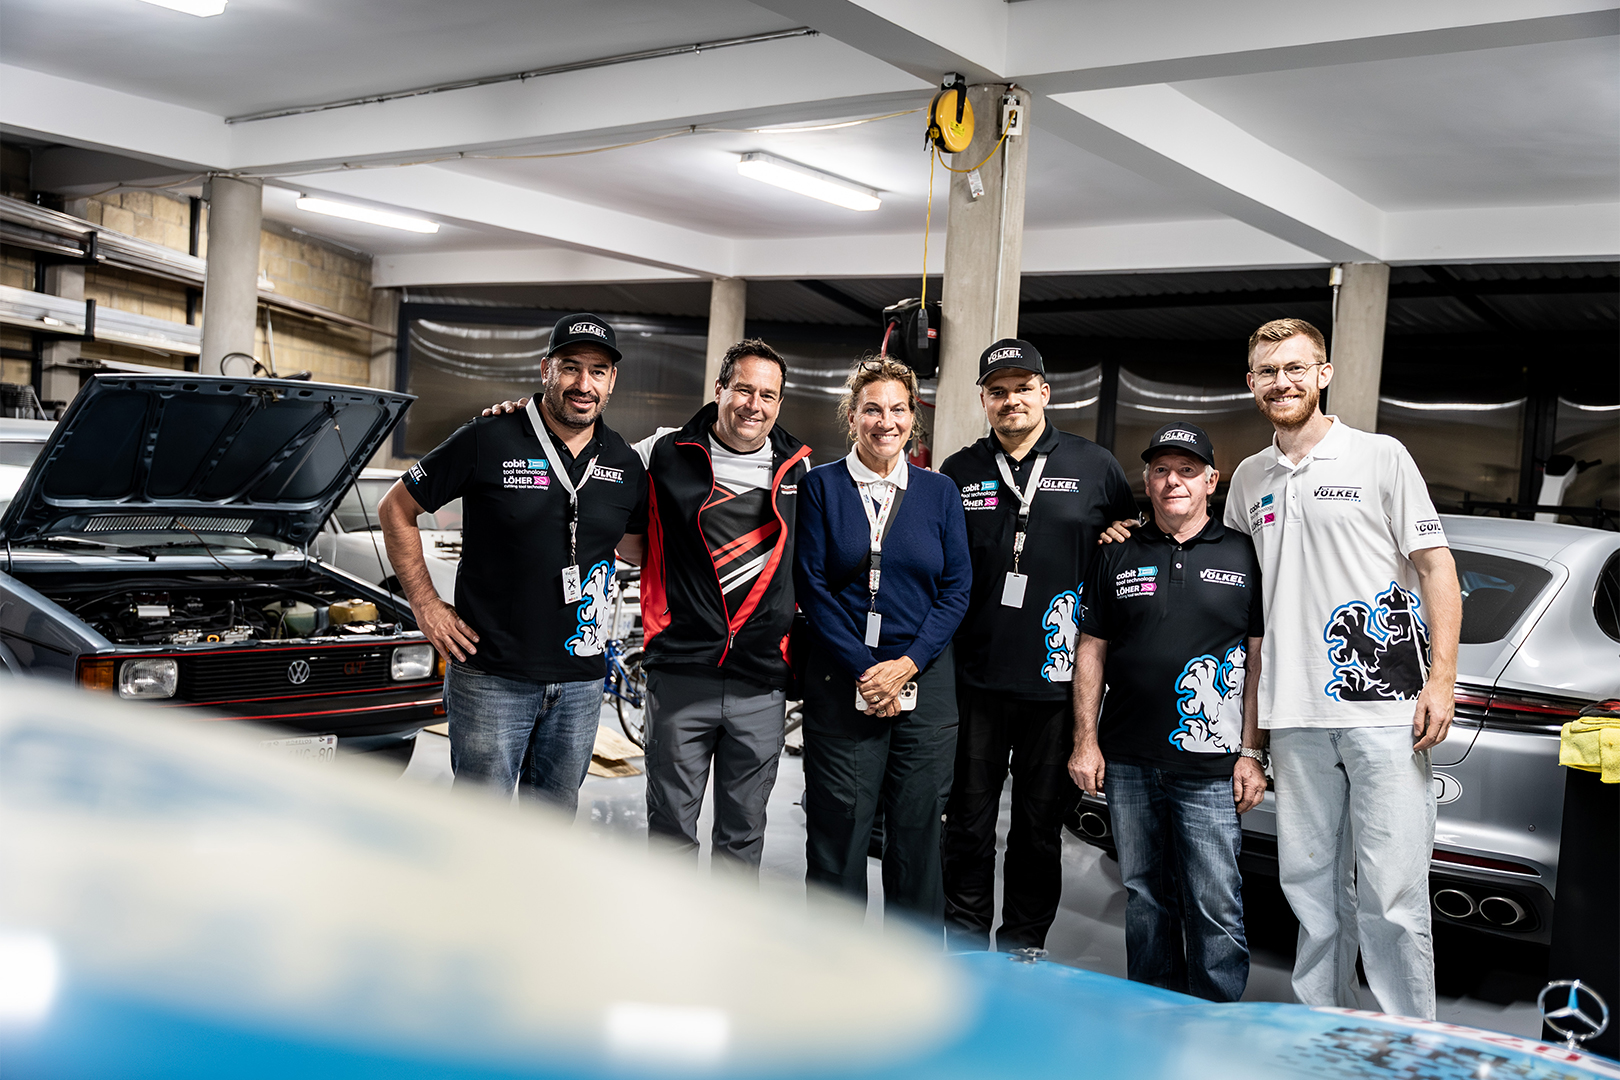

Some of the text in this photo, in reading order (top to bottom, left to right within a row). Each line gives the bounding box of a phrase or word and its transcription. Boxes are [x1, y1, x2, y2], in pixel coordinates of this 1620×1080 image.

[502, 459, 527, 468] cobit
[503, 475, 533, 484] LÖHER
[962, 483, 980, 493] cobit
[1313, 486, 1361, 499] VÖLKEL
[1116, 569, 1137, 580] cobit
[1200, 569, 1245, 584] VÖLKEL
[1126, 576, 1156, 584] technology
[1115, 584, 1140, 597] LÖHER
